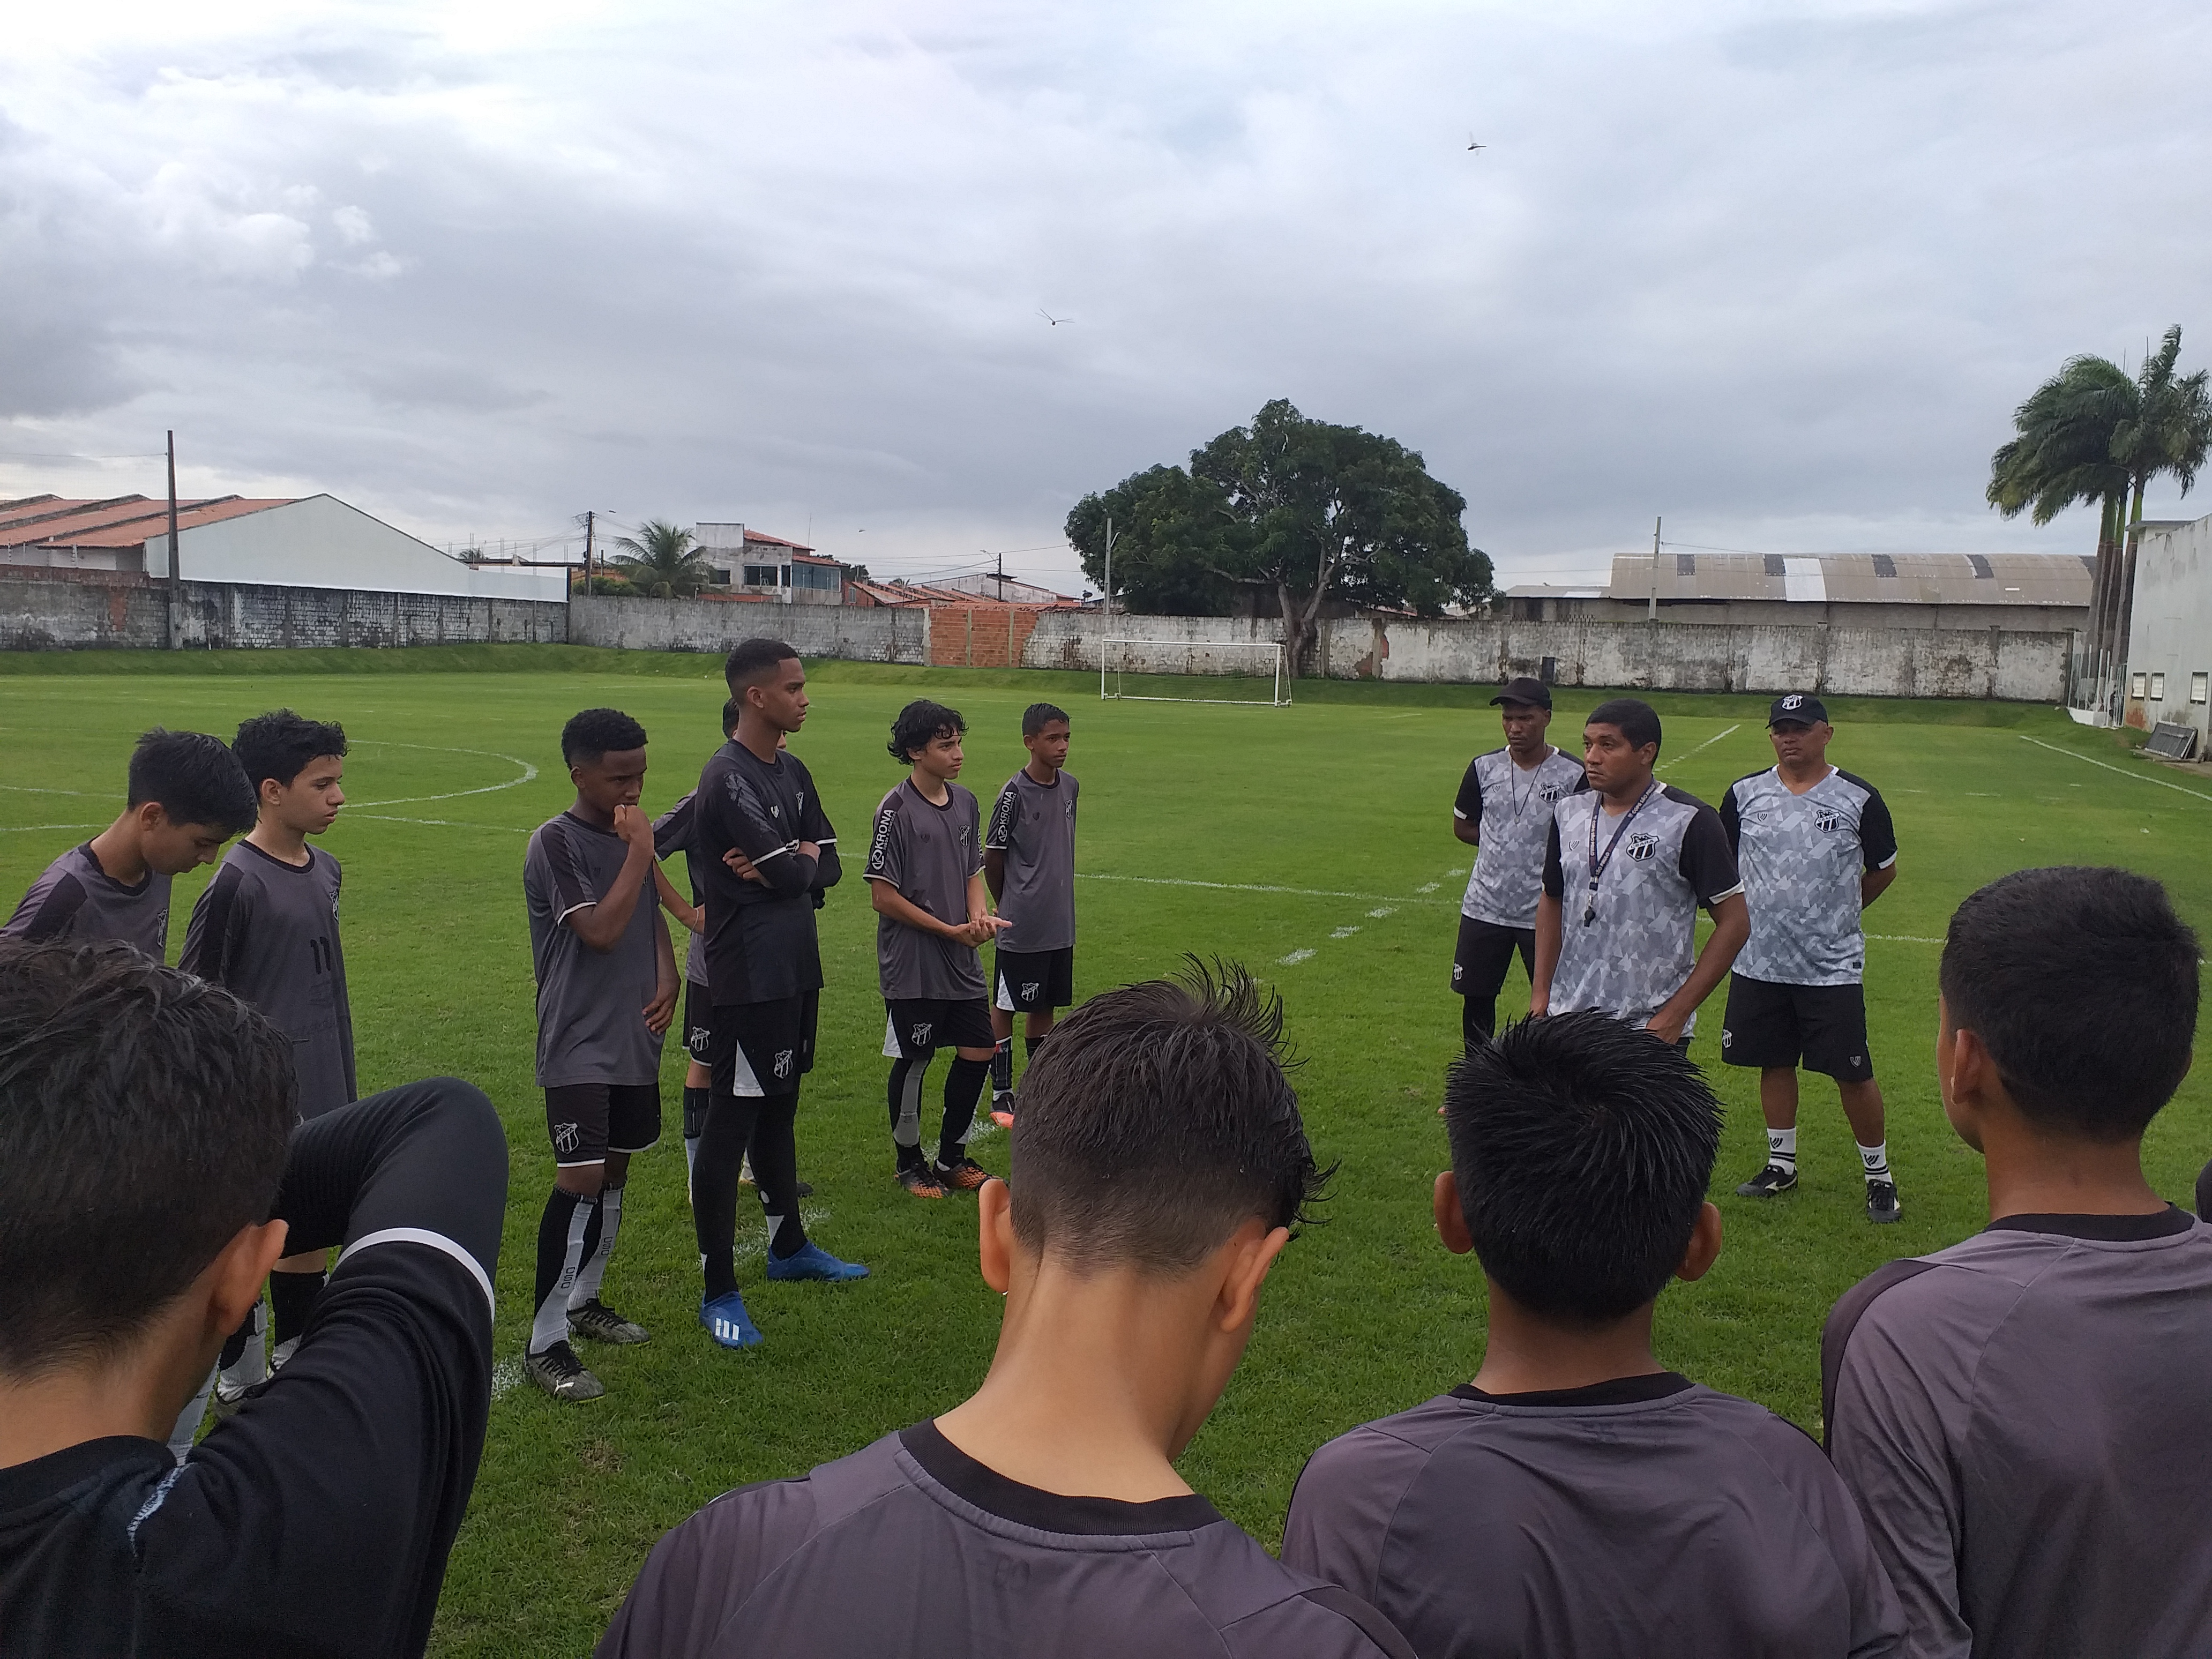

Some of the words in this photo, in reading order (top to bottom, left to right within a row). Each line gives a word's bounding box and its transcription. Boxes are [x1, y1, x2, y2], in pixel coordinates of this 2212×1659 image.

[999, 791, 1014, 825] KRONA
[875, 810, 894, 850] KRONA
[310, 937, 331, 974] 11
